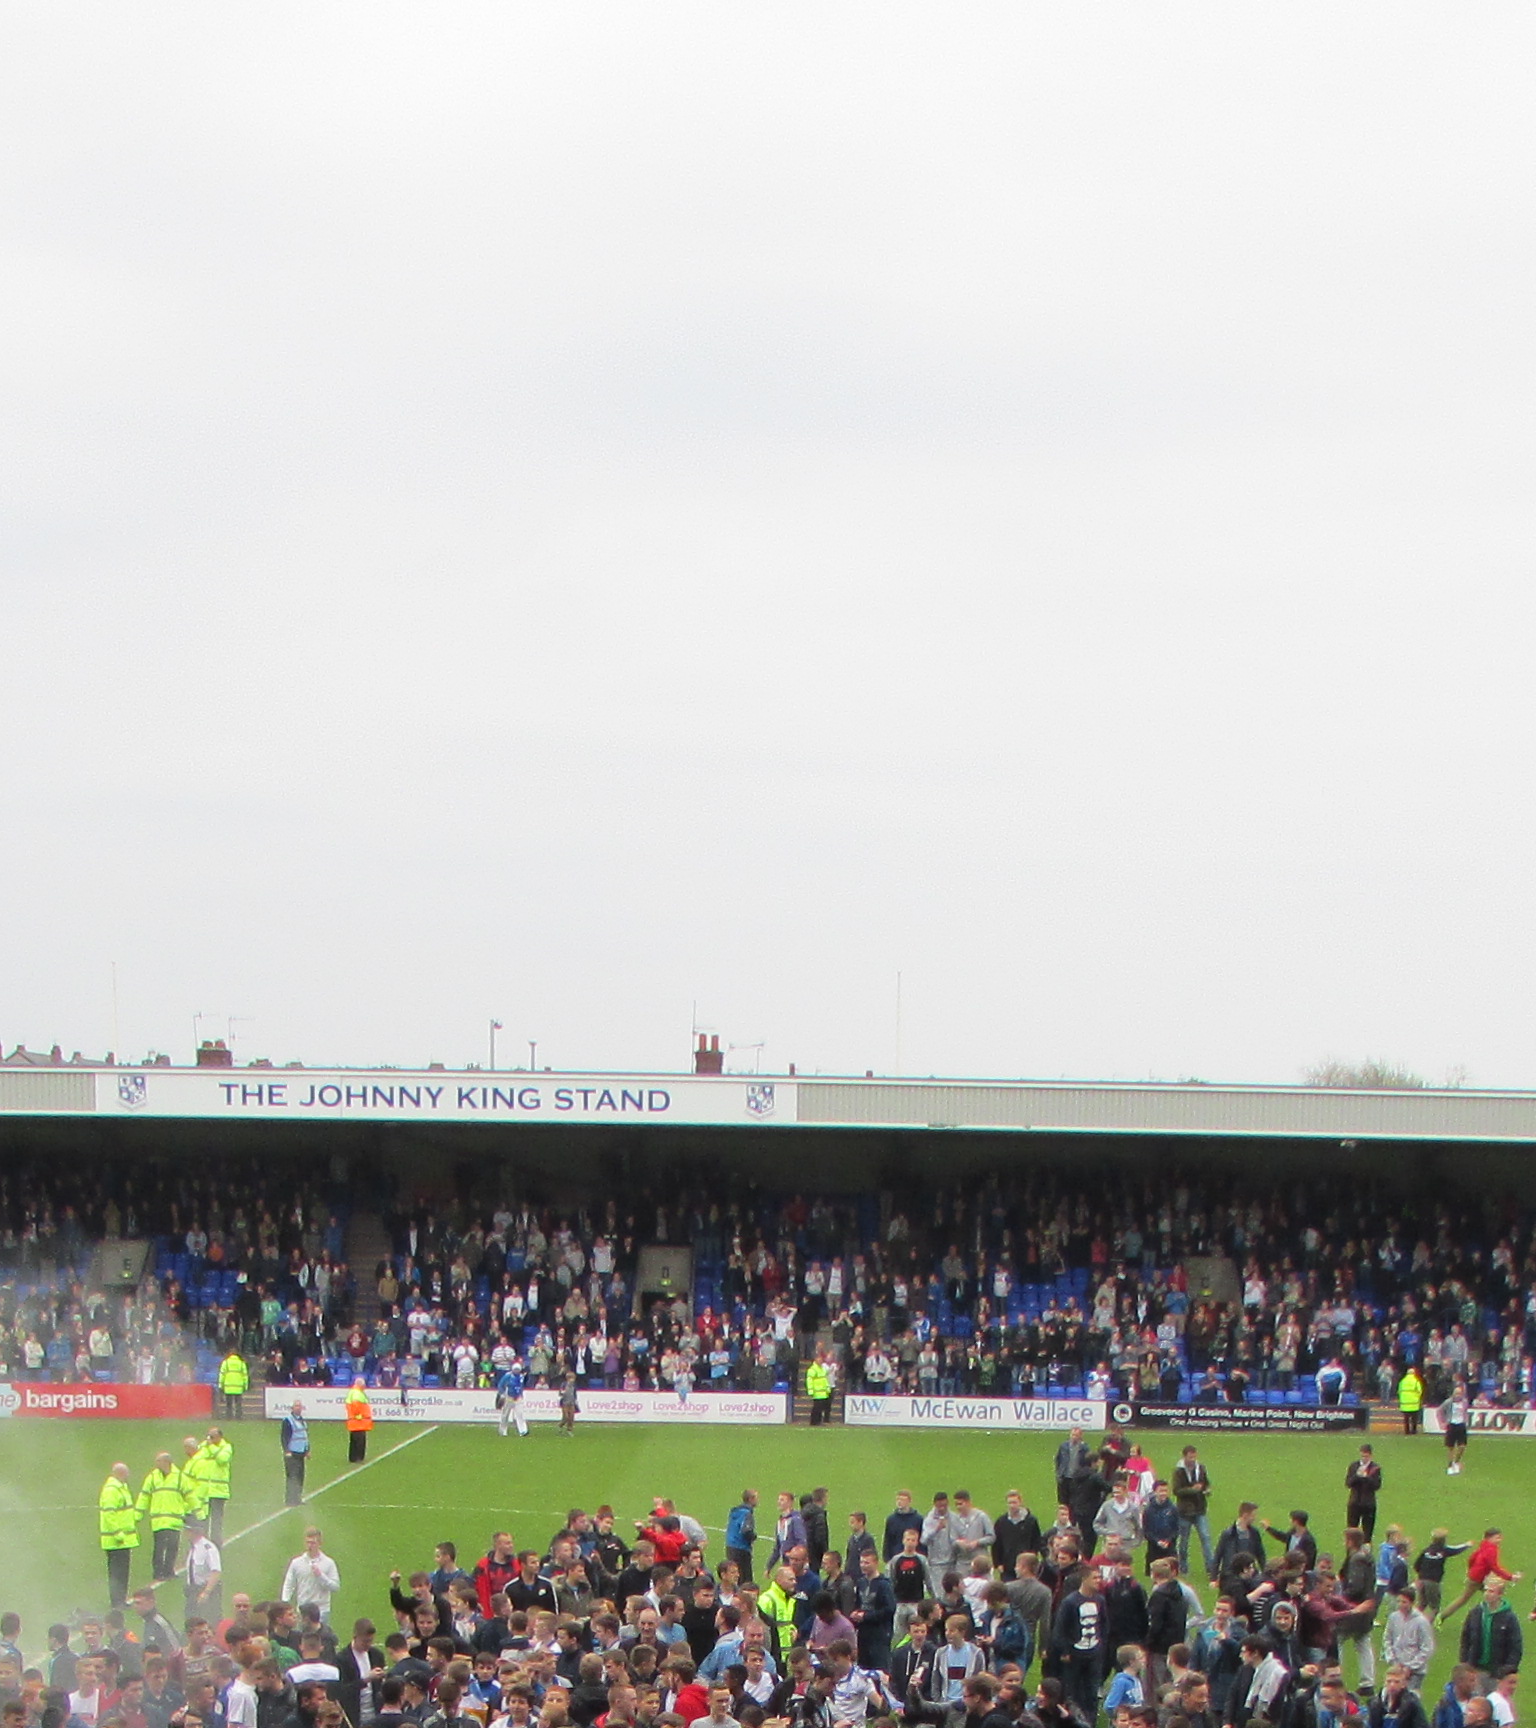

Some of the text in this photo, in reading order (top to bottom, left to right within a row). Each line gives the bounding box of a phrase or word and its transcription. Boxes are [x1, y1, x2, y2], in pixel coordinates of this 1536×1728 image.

[219, 1082, 672, 1113] THE JOHNNY KING STAND
[26, 1389, 119, 1414] bargains
[586, 1401, 643, 1412] Love2shop
[653, 1401, 709, 1413] Love2shop
[719, 1403, 775, 1414] Love2shop
[850, 1398, 885, 1414] MW
[910, 1399, 1093, 1422] McEwan Wallace
[1293, 1410, 1315, 1419] New
[1316, 1410, 1355, 1421] Brighton
[1467, 1412, 1528, 1431] LLOW
